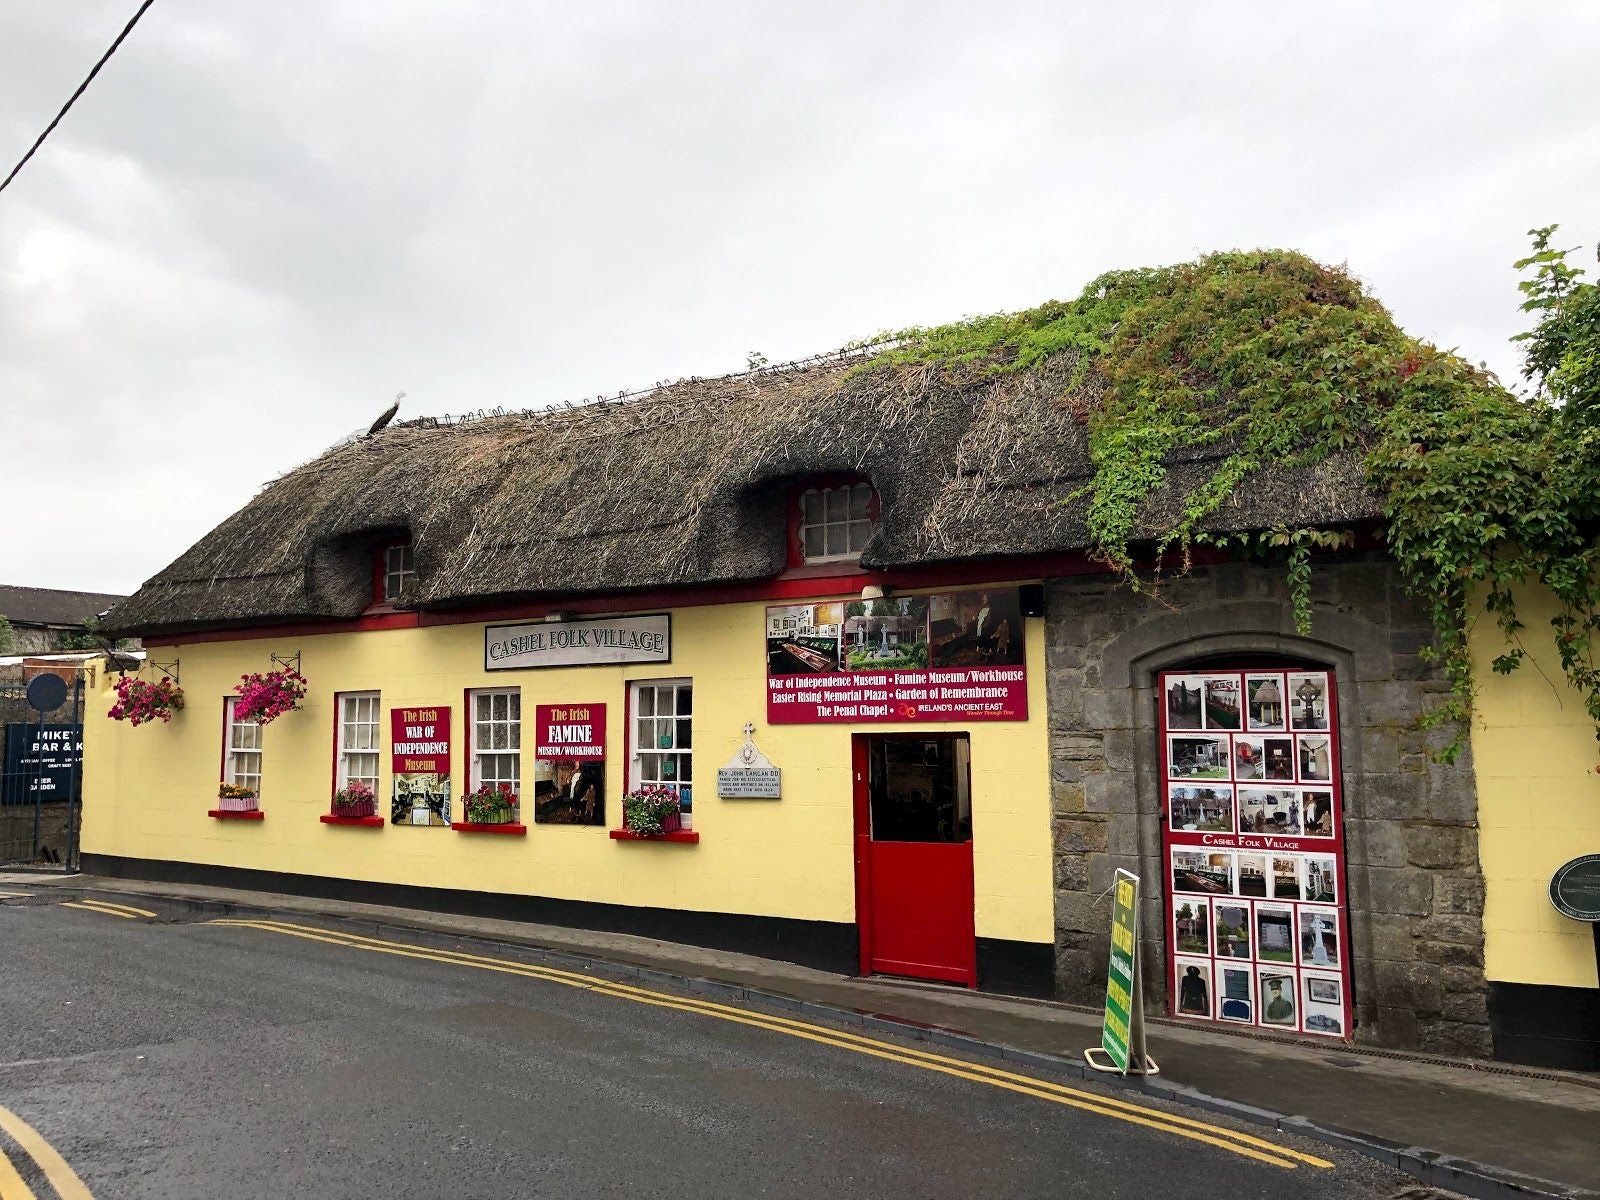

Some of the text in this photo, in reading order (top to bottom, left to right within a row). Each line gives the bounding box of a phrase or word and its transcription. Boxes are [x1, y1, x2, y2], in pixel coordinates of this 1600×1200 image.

[490, 628, 664, 660] CASHEL FOLK VILLAGE
[769, 670, 1024, 689] War of Independence Museum Famine Museum/Workhouse
[772, 687, 1008, 703] Easter Rising Memorial Plaza Garden of Remembrance
[817, 704, 888, 717] The Penal Chapel
[918, 703, 1003, 712] IRELAND'S ANCIENT EAST
[403, 710, 437, 722] The Irish
[551, 708, 590, 721] The Irish
[405, 725, 435, 738] WAR OF
[548, 725, 592, 743] FAMINE
[32, 743, 59, 751] BAR
[63, 742, 71, 751] &
[393, 742, 448, 755] INDEPENDENCE
[537, 746, 603, 756] MUSEUM/WORKHOUSE
[405, 759, 436, 771] Museum
[1202, 834, 1235, 846] CASHEL
[1238, 836, 1260, 847] FOLK
